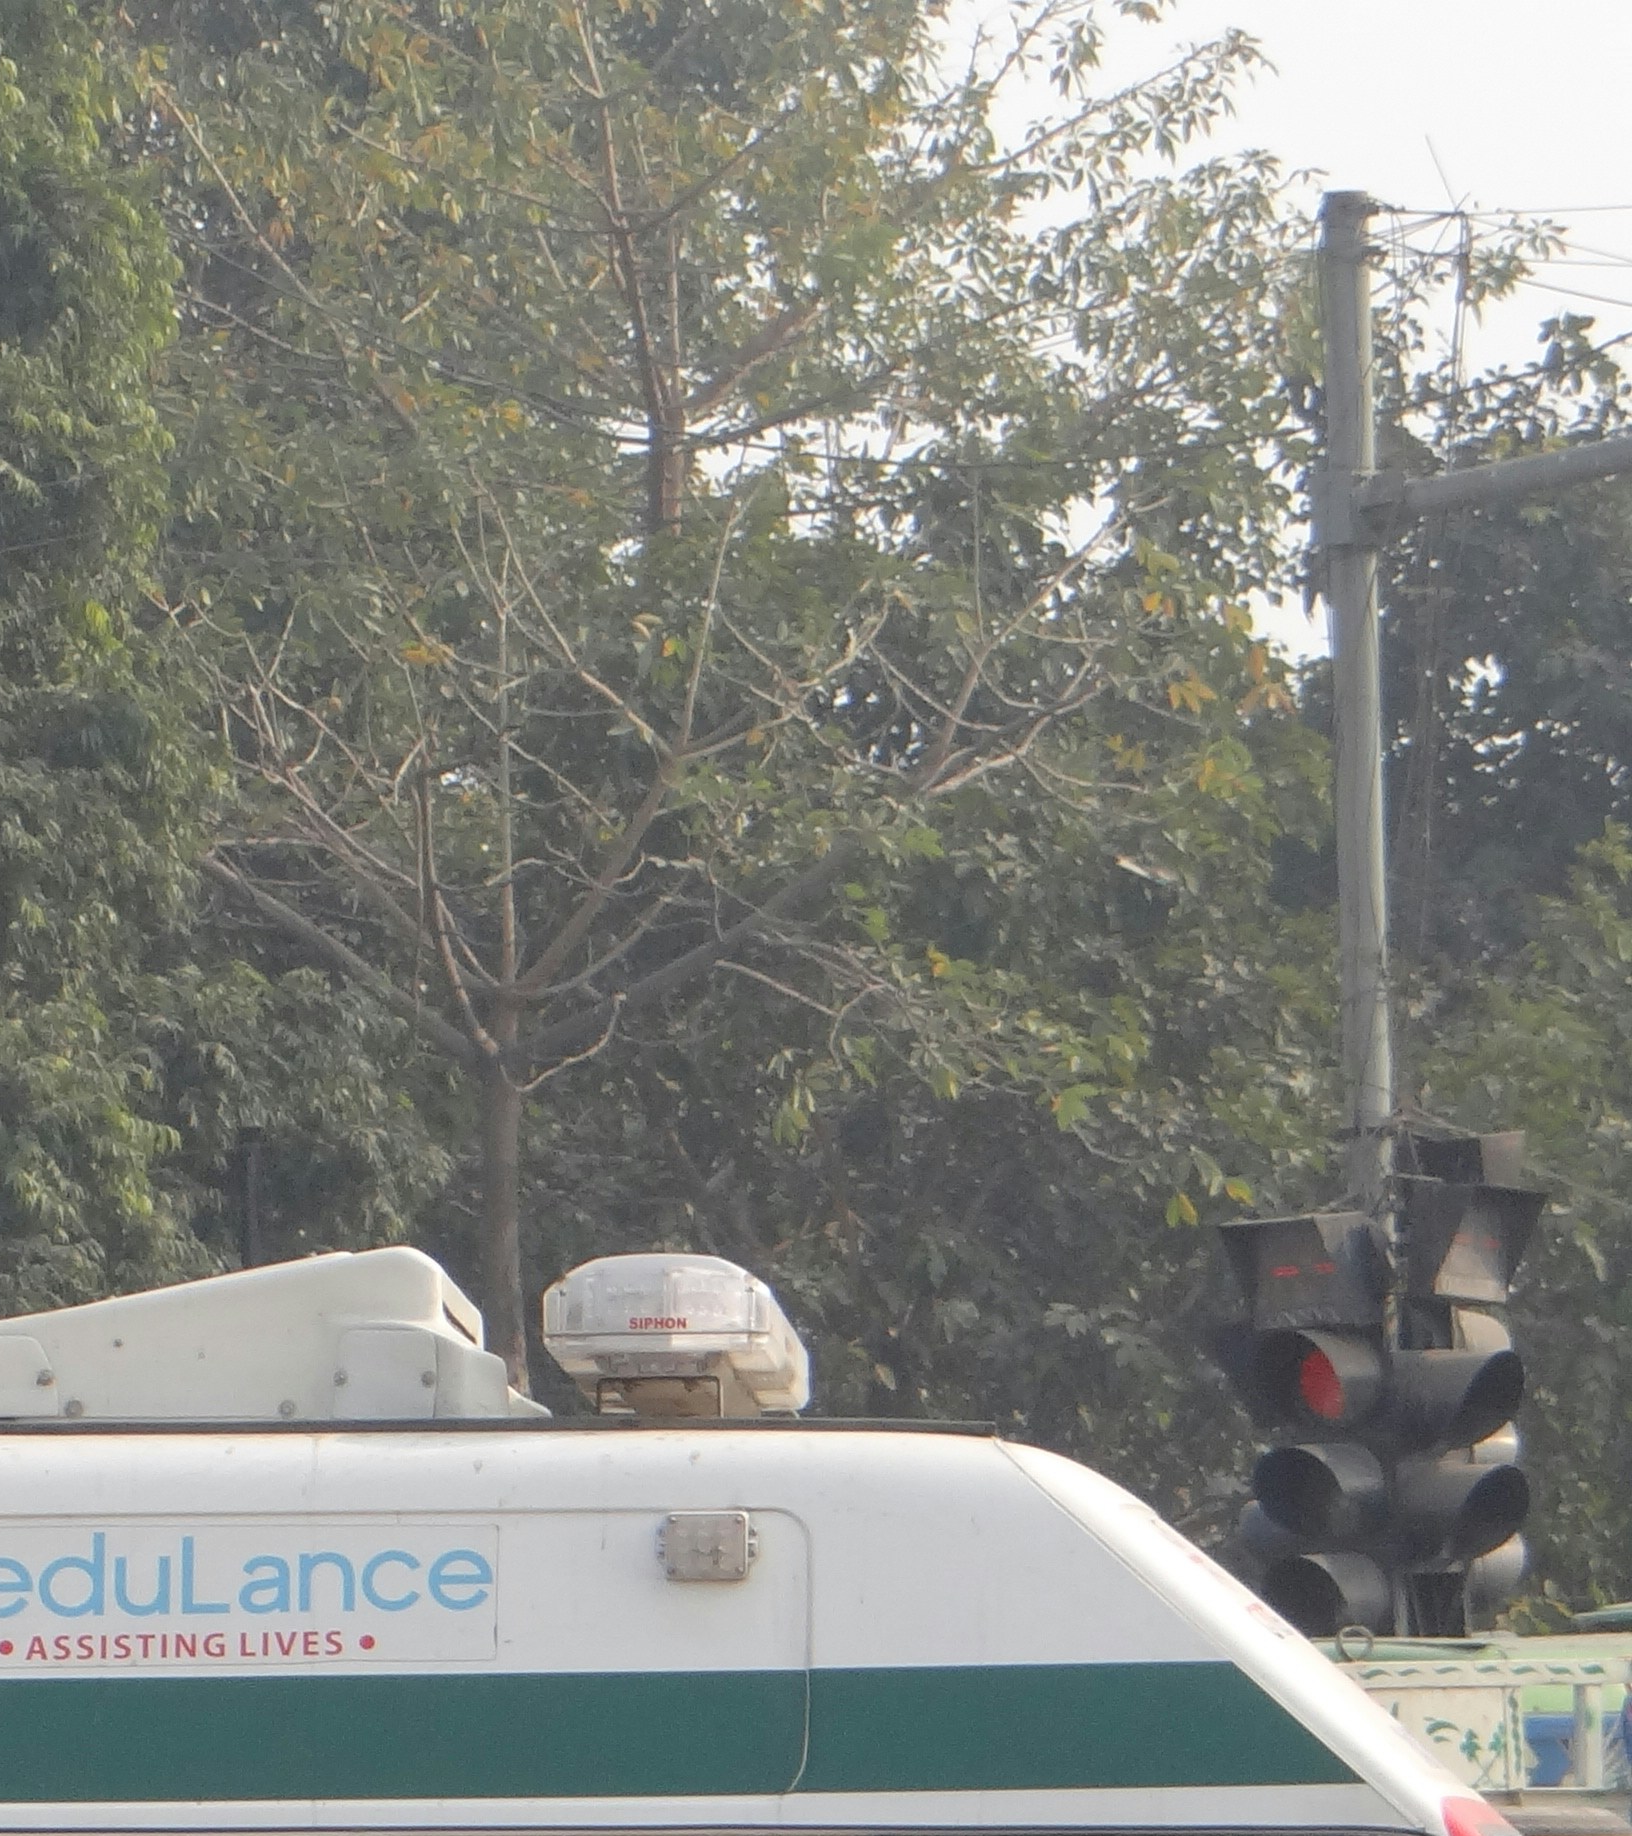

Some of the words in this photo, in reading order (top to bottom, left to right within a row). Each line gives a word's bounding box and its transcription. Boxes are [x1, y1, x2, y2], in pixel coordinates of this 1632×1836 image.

[629, 1316, 689, 1330] SIPHON
[25, 1631, 228, 1661] ASSISTING
[238, 1630, 344, 1657] LIVES
